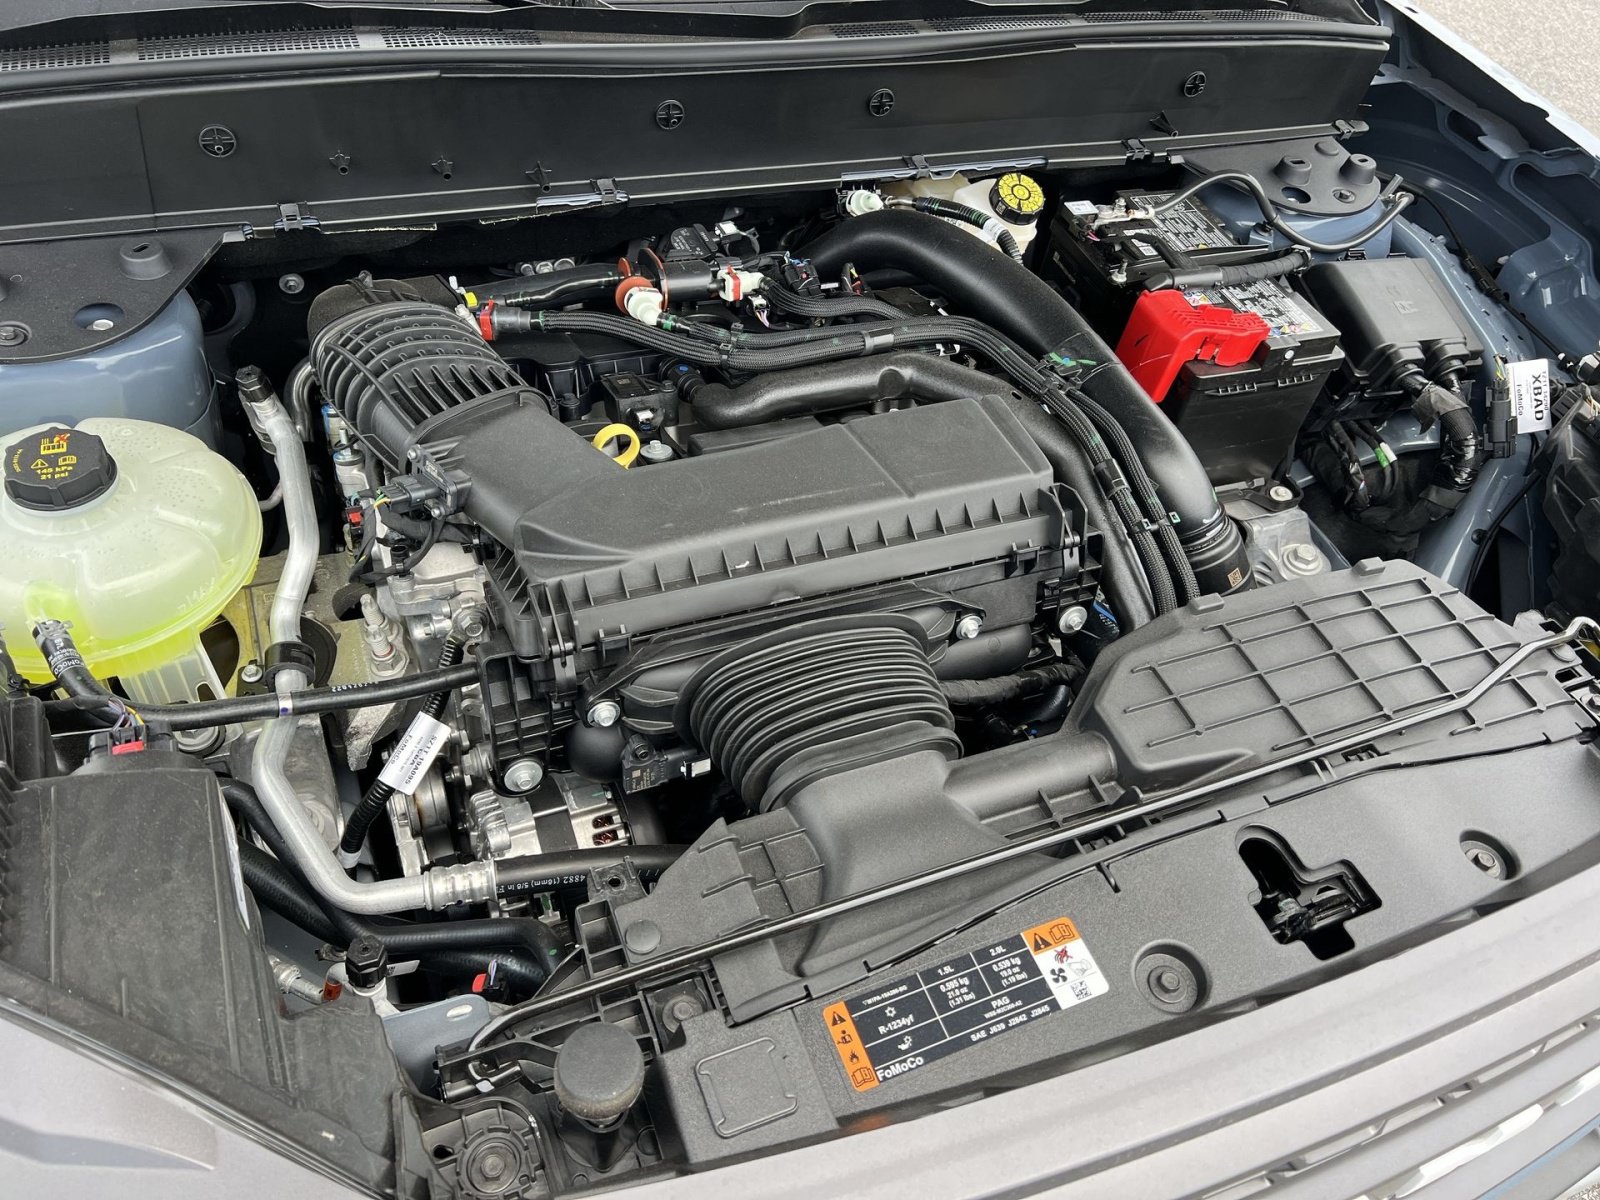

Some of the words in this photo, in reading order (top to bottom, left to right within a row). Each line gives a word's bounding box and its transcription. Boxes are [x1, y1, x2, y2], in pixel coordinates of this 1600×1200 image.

[1532, 375, 1544, 420] XBAD
[54, 658, 84, 676] oMoCo
[531, 876, 560, 887] (16mm)
[563, 874, 585, 884] 4882
[1009, 957, 1021, 965] kg
[958, 976, 970, 985] kg
[991, 996, 1010, 1008] PAG
[878, 1014, 914, 1034] R-1234yf
[970, 1030, 987, 1041] SAE
[876, 1056, 924, 1080] FoMoCo
